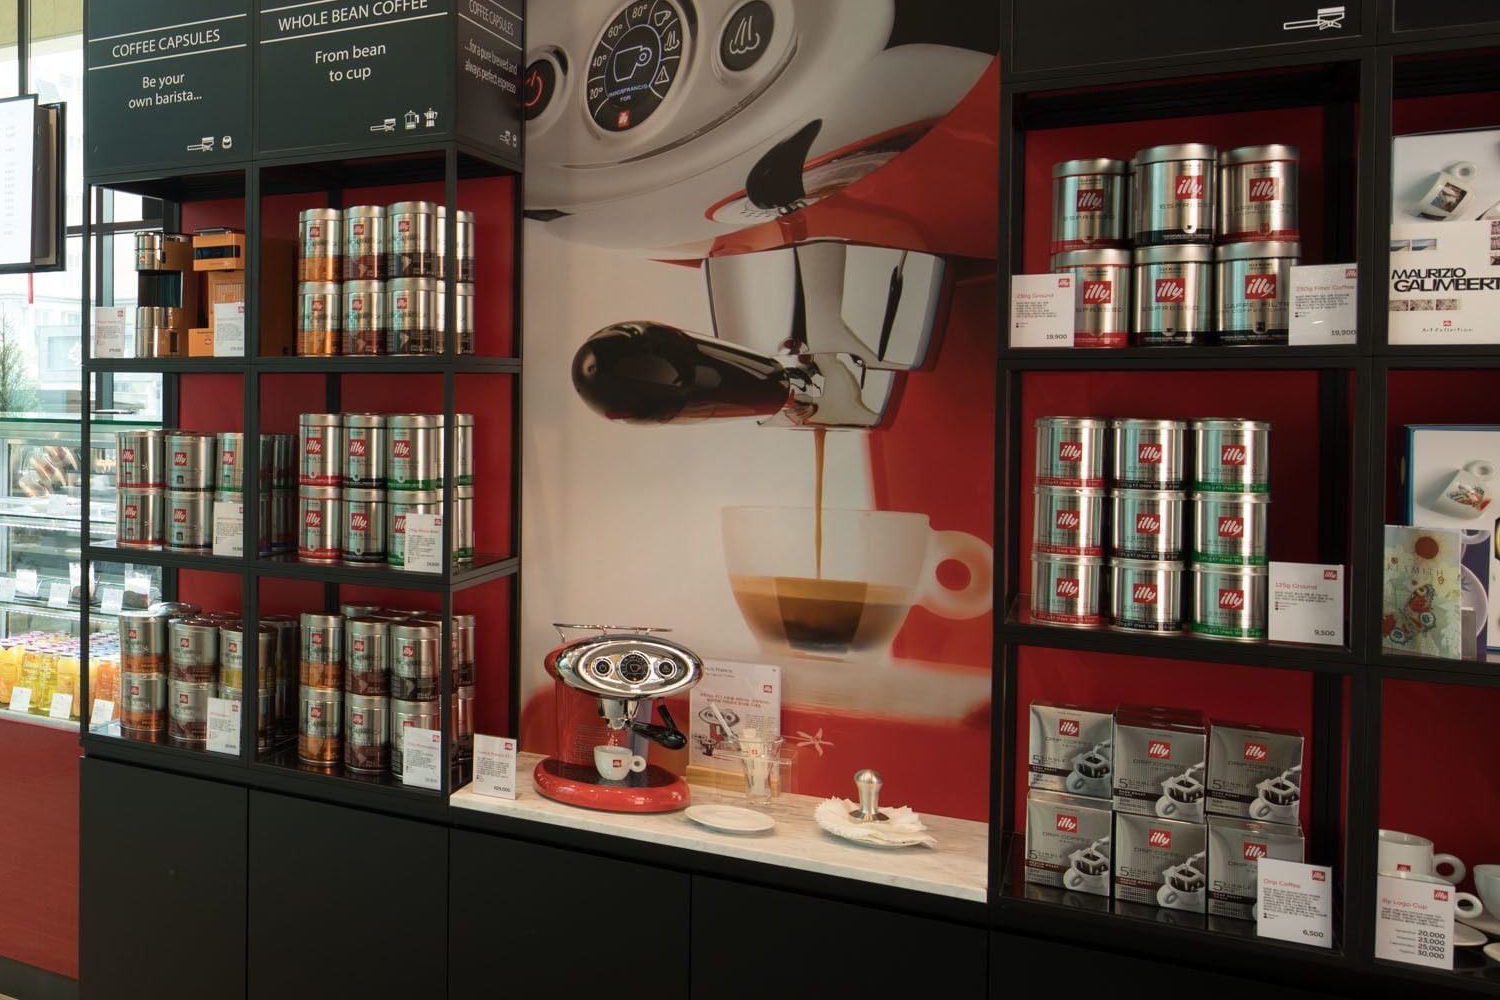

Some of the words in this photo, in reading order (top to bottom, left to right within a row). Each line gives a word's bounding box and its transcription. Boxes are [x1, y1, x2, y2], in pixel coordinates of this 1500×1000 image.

[278, 11, 329, 32] WHOLE
[331, 4, 369, 23] BEAN
[468, 0, 489, 22] COFFEE
[488, 11, 514, 36] CAPSULES
[112, 39, 156, 58] COFFEE
[158, 28, 220, 51] CAPSULES
[315, 50, 349, 65] From
[352, 44, 386, 59] bean
[329, 69, 343, 82] to
[346, 66, 372, 80] cup
[465, 58, 481, 79] always
[497, 79, 516, 95] espresso
[142, 76, 156, 89] Be
[158, 73, 185, 90] your
[128, 97, 152, 109] own
[155, 90, 202, 106] barista...
[1177, 177, 1203, 197] illy
[1251, 180, 1277, 198] illy
[1077, 191, 1102, 209] illy
[1391, 267, 1466, 279] MAURIZIO
[1085, 283, 1110, 302] illy
[1158, 281, 1184, 299] illy
[1246, 277, 1275, 297] illy
[307, 439, 321, 453] illy
[350, 441, 364, 455] illy
[394, 442, 410, 457] illy
[1060, 445, 1082, 459] illy
[1140, 447, 1161, 461] illy
[1223, 448, 1245, 462] illy
[306, 512, 320, 525] illy
[352, 515, 367, 529] illy
[1058, 512, 1078, 526] illy
[1139, 515, 1159, 530] illy
[1220, 519, 1243, 535] illy
[1058, 580, 1078, 595] illy
[1134, 586, 1156, 601] illy
[1220, 591, 1243, 607] illy
[1060, 722, 1078, 735] illy
[1150, 744, 1170, 757] illy
[1246, 745, 1265, 759] illy
[1119, 778, 1128, 788] 5
[1213, 779, 1221, 789] 5
[1057, 817, 1076, 830] illy
[1151, 832, 1170, 846] illy
[1029, 850, 1038, 860] 5
[1120, 866, 1129, 877] 5
[1213, 880, 1223, 891] 5
[1302, 929, 1324, 938] 6,500
[1417, 929, 1445, 940] 20,000
